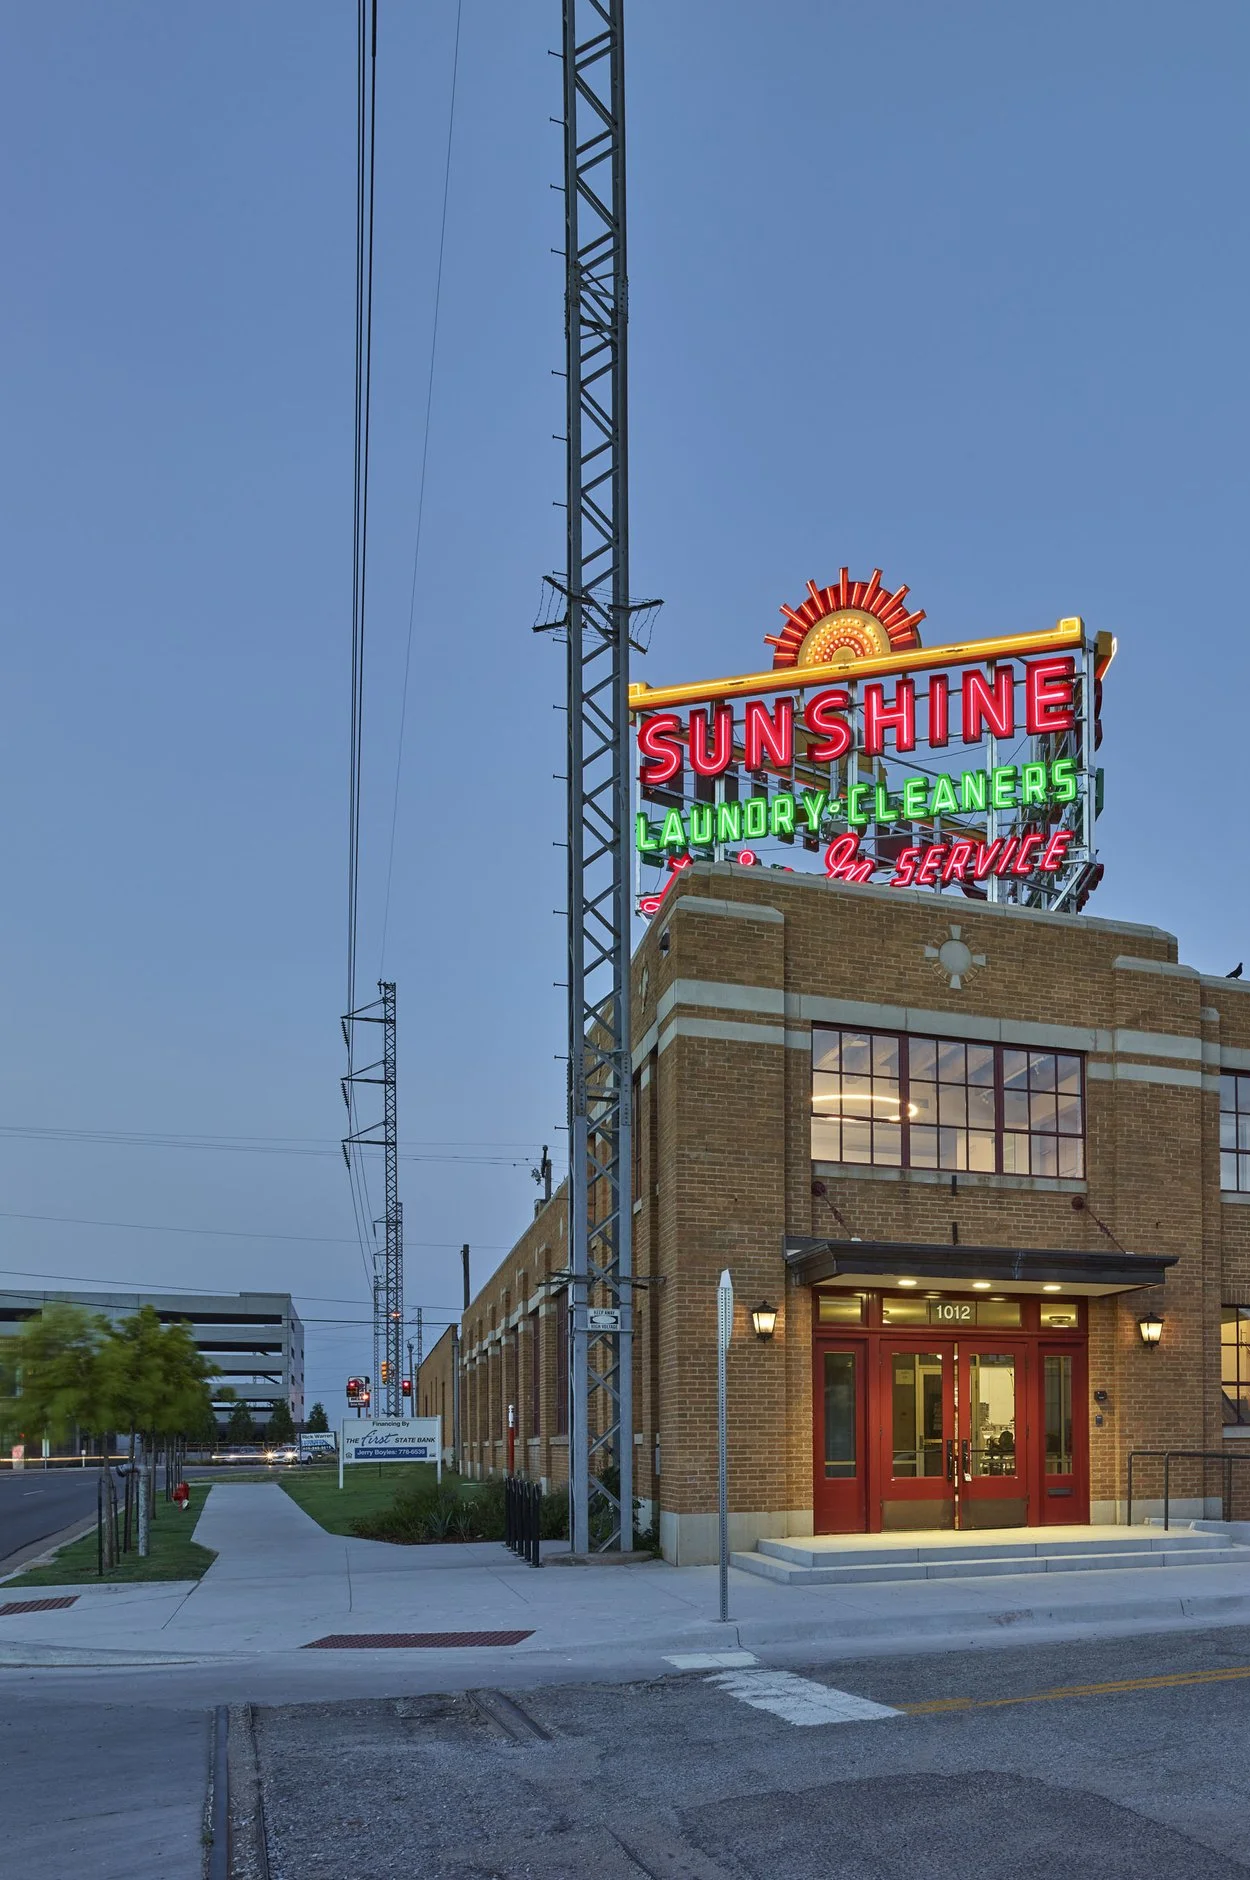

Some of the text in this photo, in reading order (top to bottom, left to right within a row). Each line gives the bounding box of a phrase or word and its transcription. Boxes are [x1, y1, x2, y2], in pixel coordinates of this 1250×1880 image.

[638, 656, 1075, 785] SUNSHINE
[890, 830, 1074, 888] SERVICE
[936, 1305, 971, 1319] 1012
